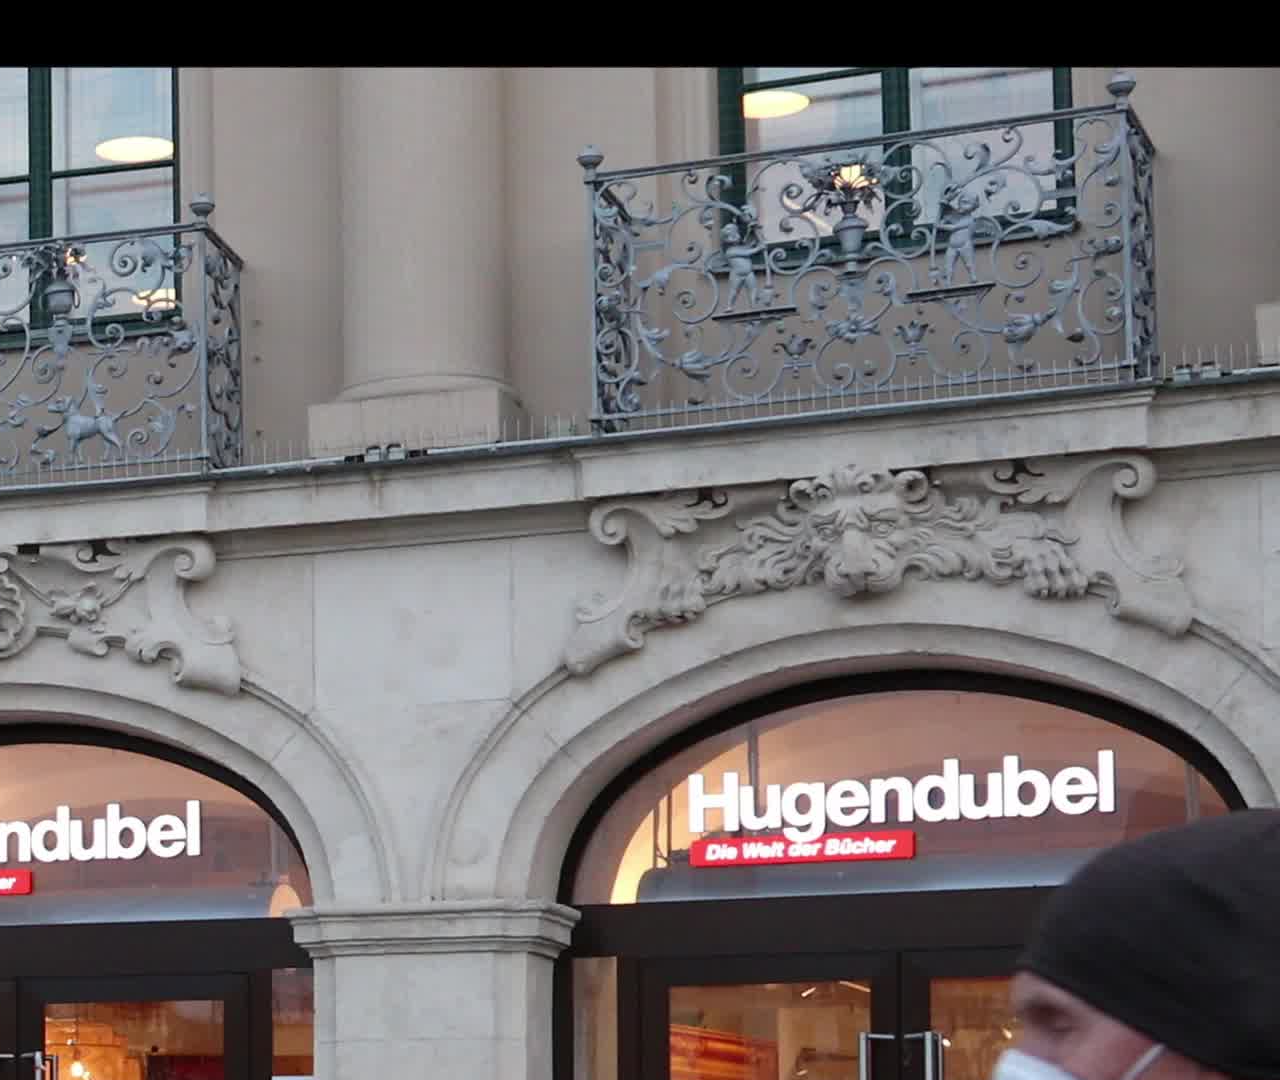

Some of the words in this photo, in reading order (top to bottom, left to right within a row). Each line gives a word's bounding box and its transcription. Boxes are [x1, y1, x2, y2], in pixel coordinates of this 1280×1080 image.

[688, 750, 1115, 841] Hugendubel
[705, 843, 739, 861] Die
[743, 841, 785, 859] Welt
[788, 841, 822, 858] der
[825, 837, 897, 856] Bücher
